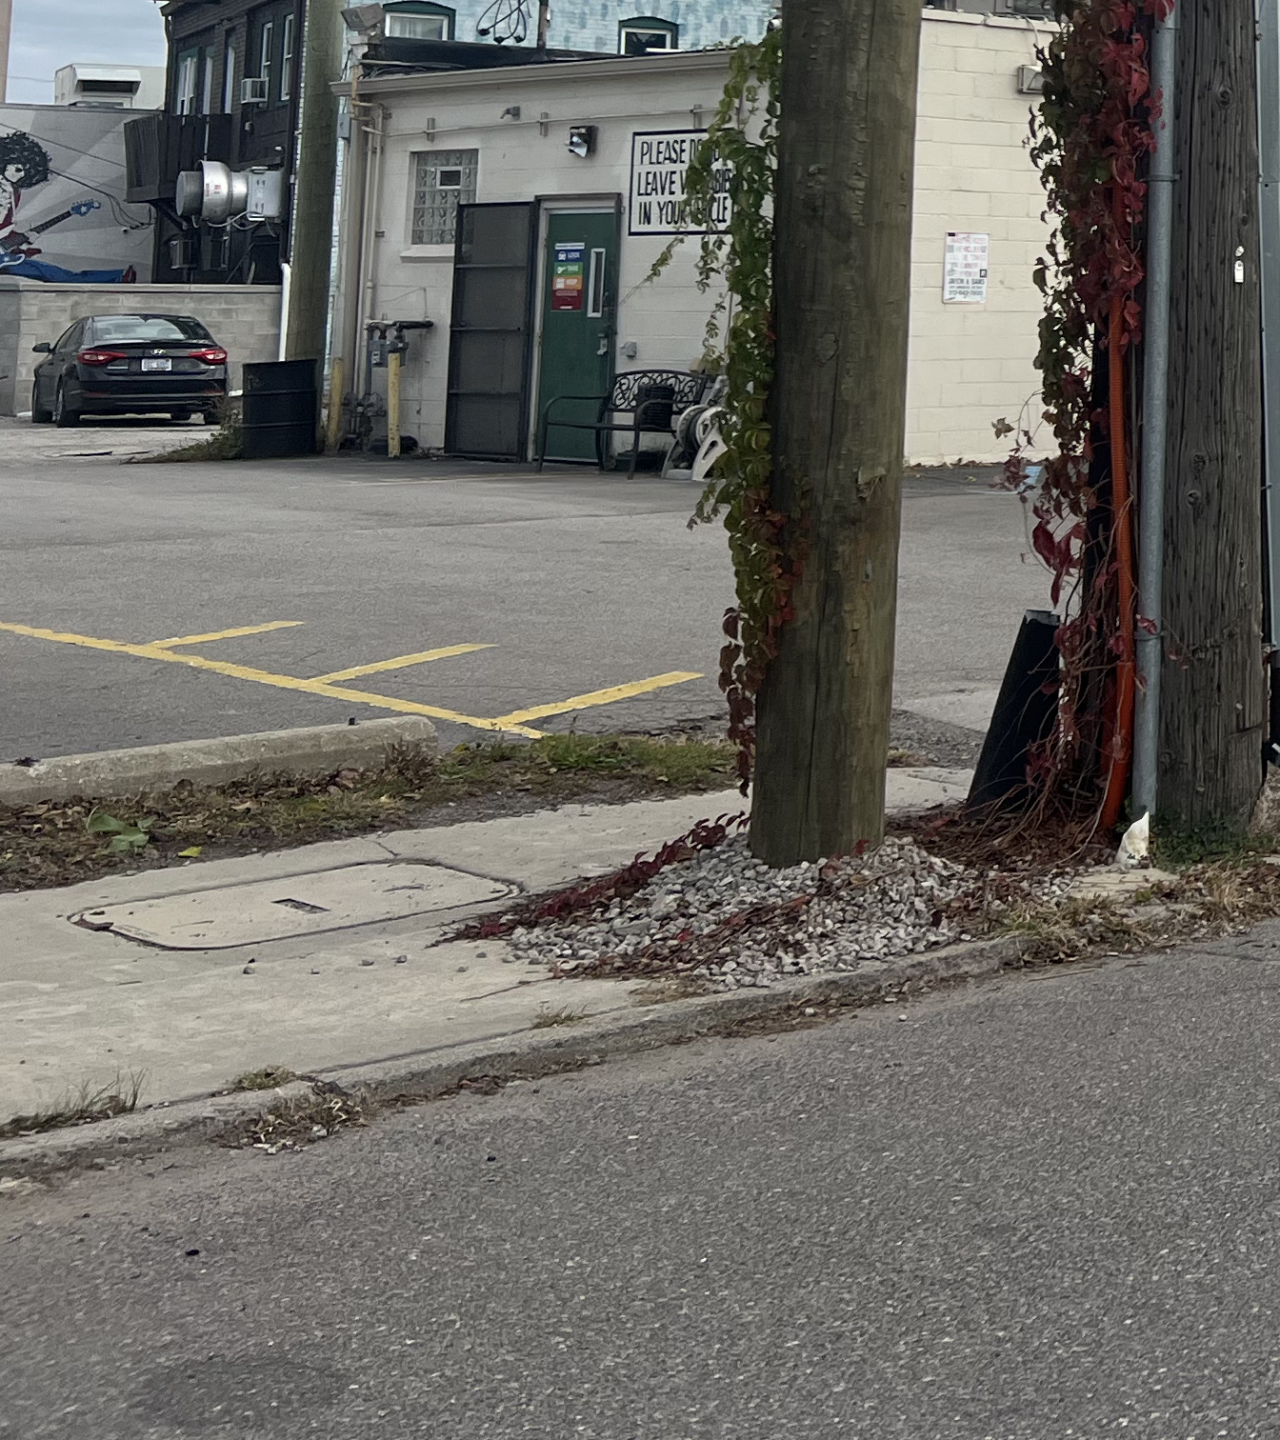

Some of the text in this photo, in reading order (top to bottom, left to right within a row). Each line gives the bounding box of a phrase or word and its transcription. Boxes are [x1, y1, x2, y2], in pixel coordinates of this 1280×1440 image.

[640, 139, 687, 165] PLEASE
[637, 170, 677, 196] LEAVE
[638, 201, 651, 225] IN
